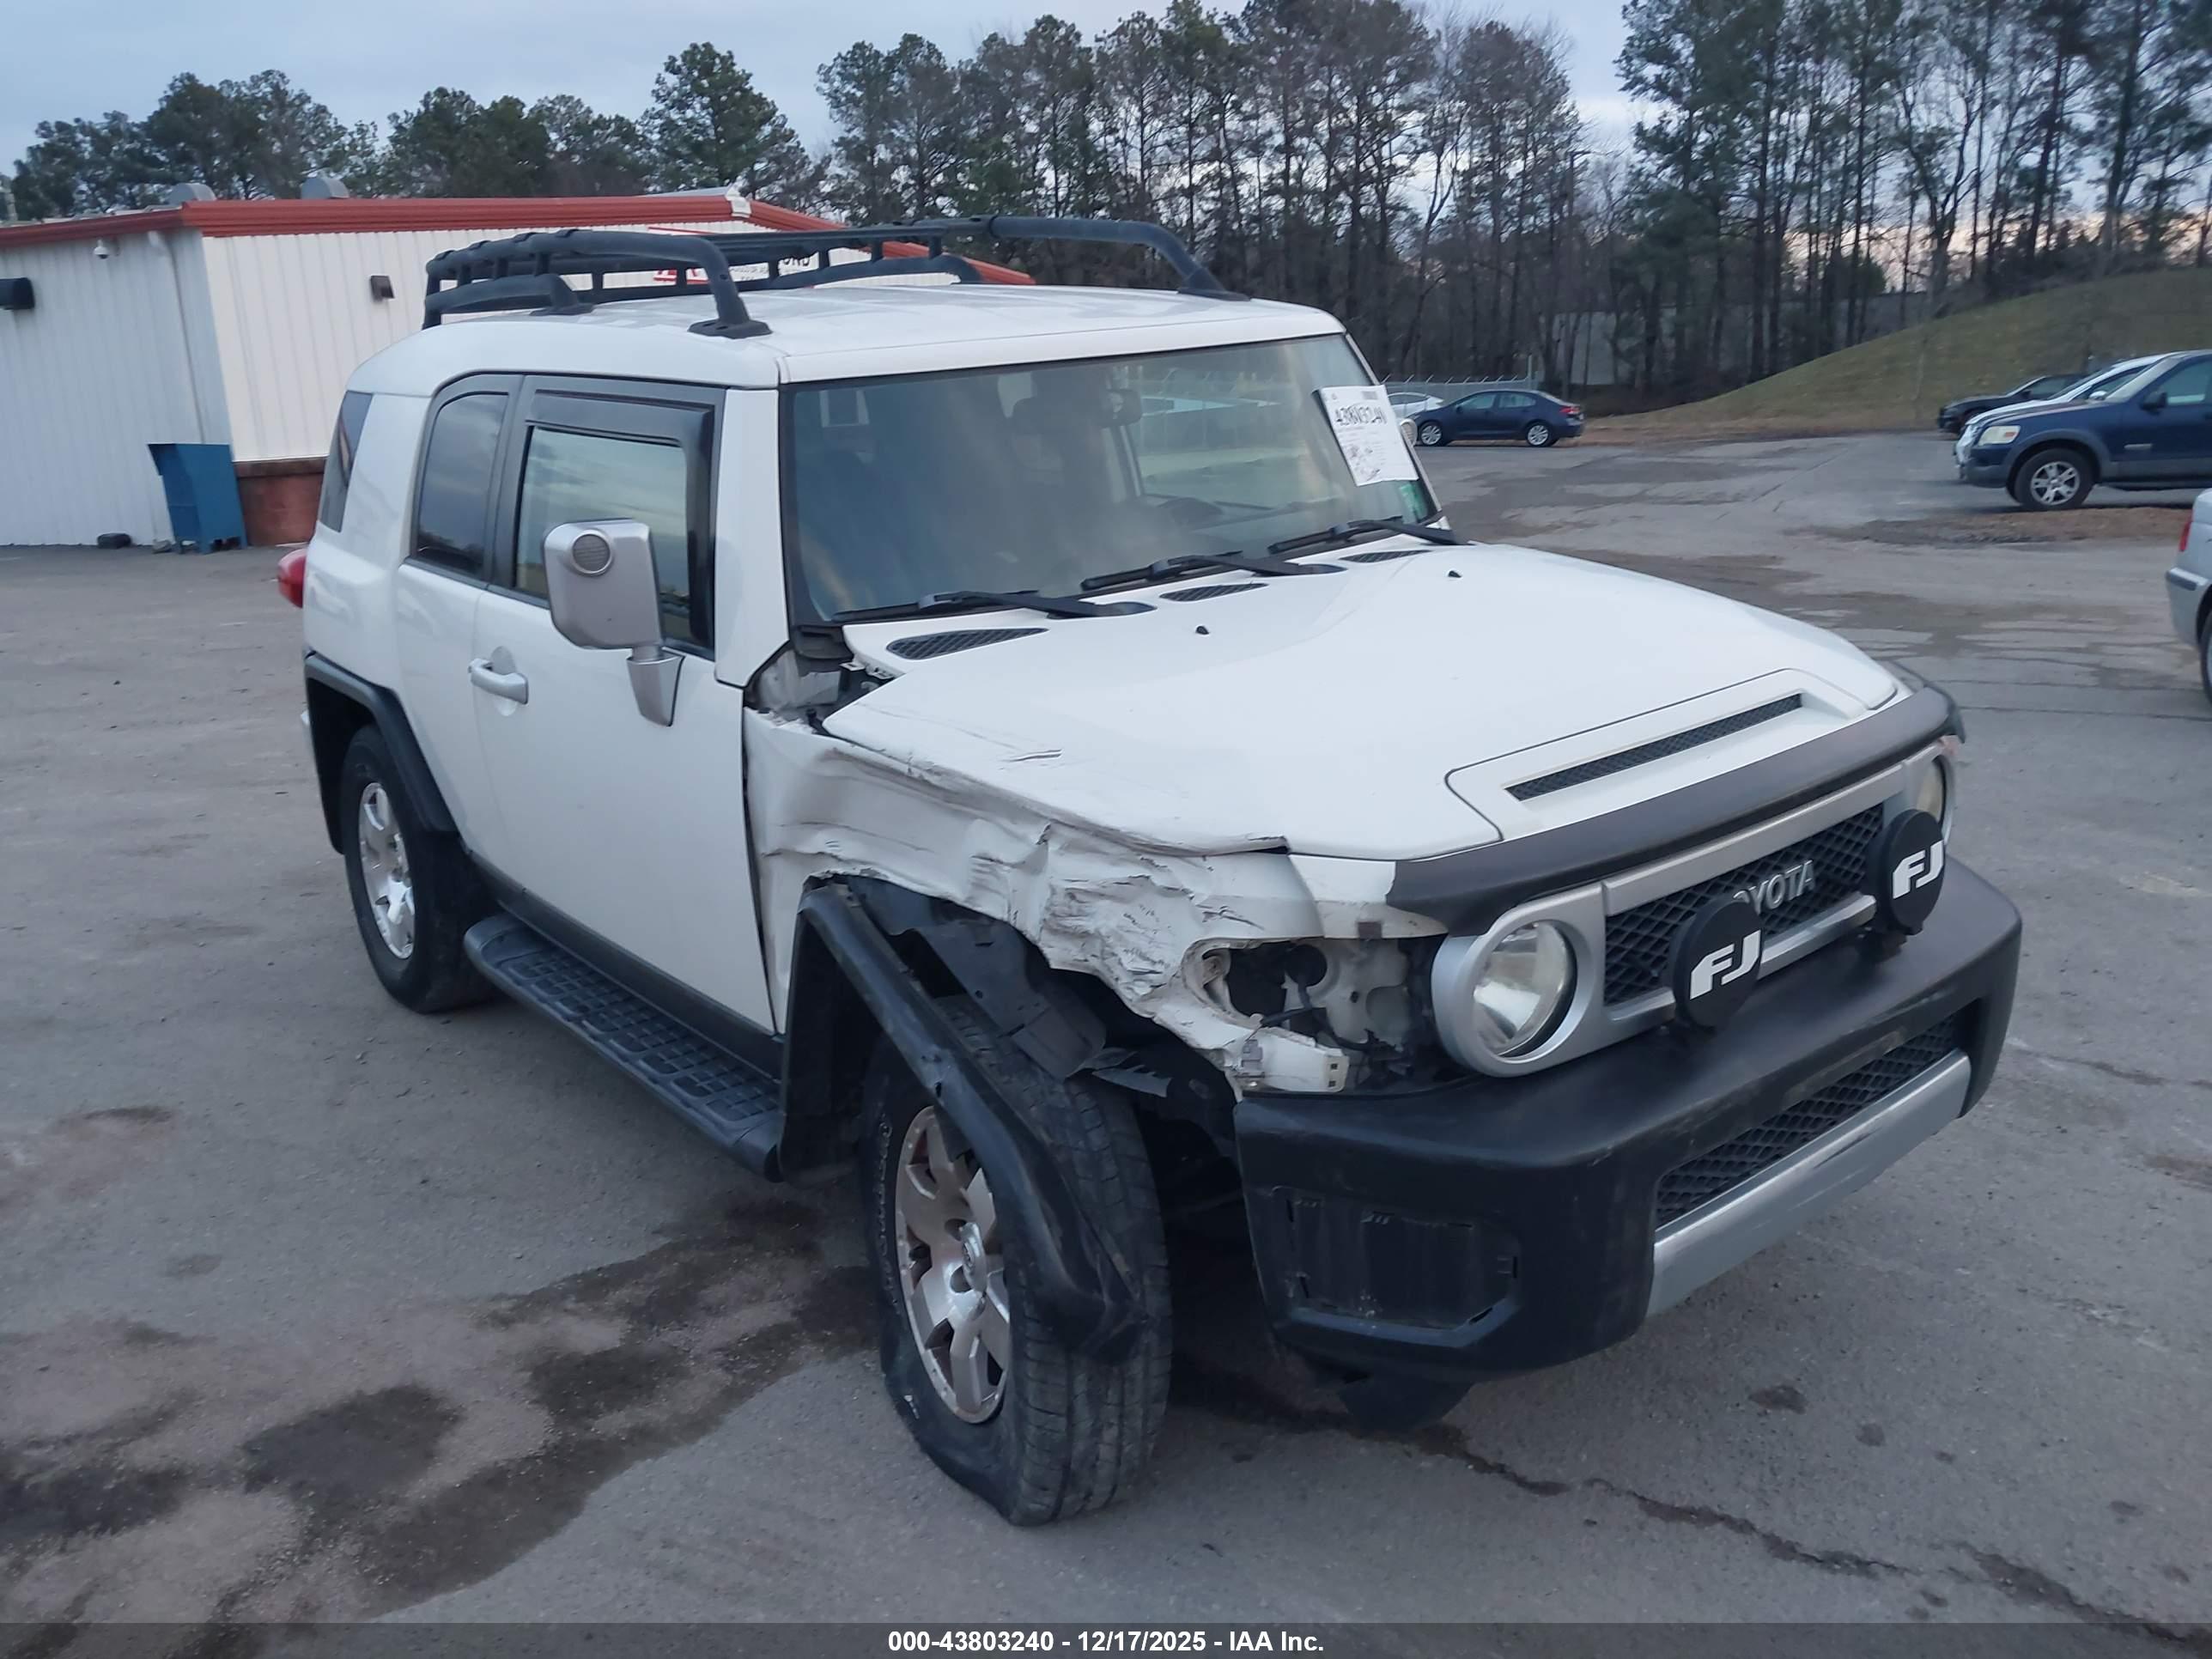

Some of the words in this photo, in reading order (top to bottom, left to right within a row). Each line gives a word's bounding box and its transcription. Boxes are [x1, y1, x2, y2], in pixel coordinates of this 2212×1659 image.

[1733, 860, 1814, 915] YOTA
[1892, 840, 1944, 899] FJ
[1689, 929, 1761, 1000] FJ
